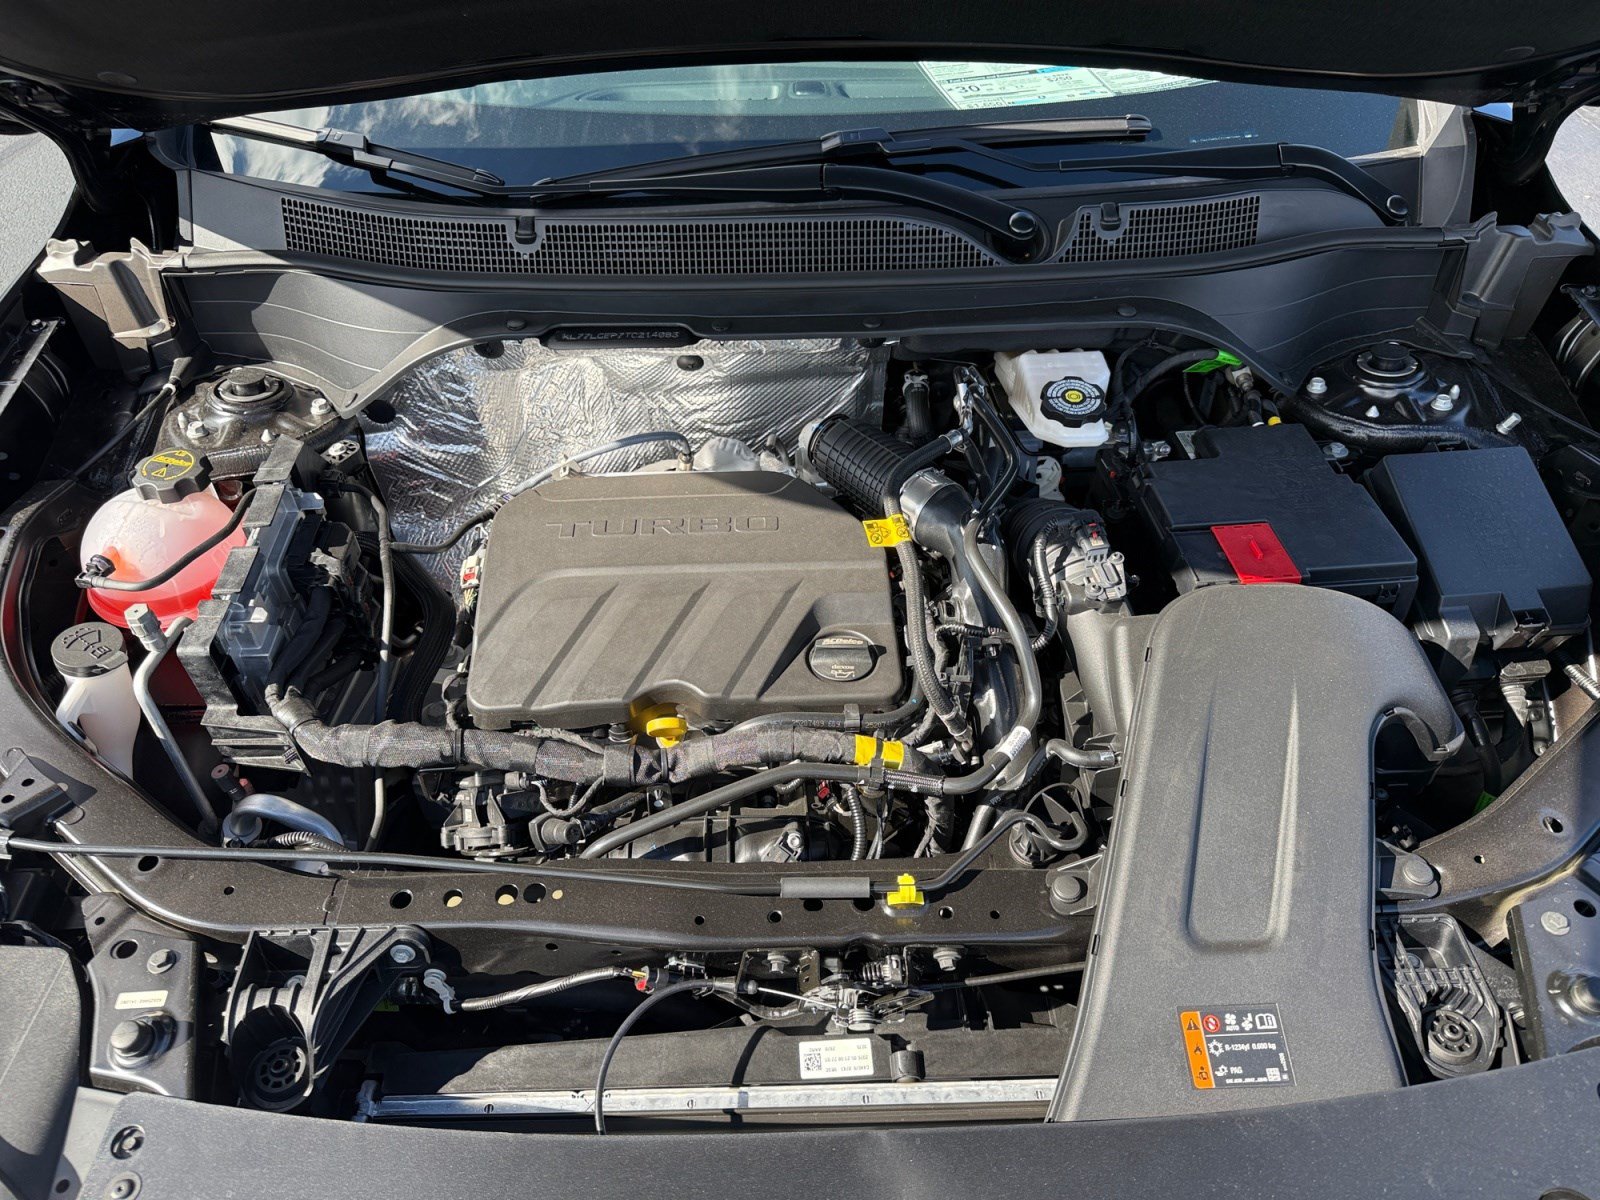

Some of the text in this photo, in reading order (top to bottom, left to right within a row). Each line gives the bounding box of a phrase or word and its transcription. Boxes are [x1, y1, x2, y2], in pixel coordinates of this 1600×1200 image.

[955, 84, 981, 94] 30
[545, 515, 780, 539] TURBO
[822, 638, 864, 646] ACDelco
